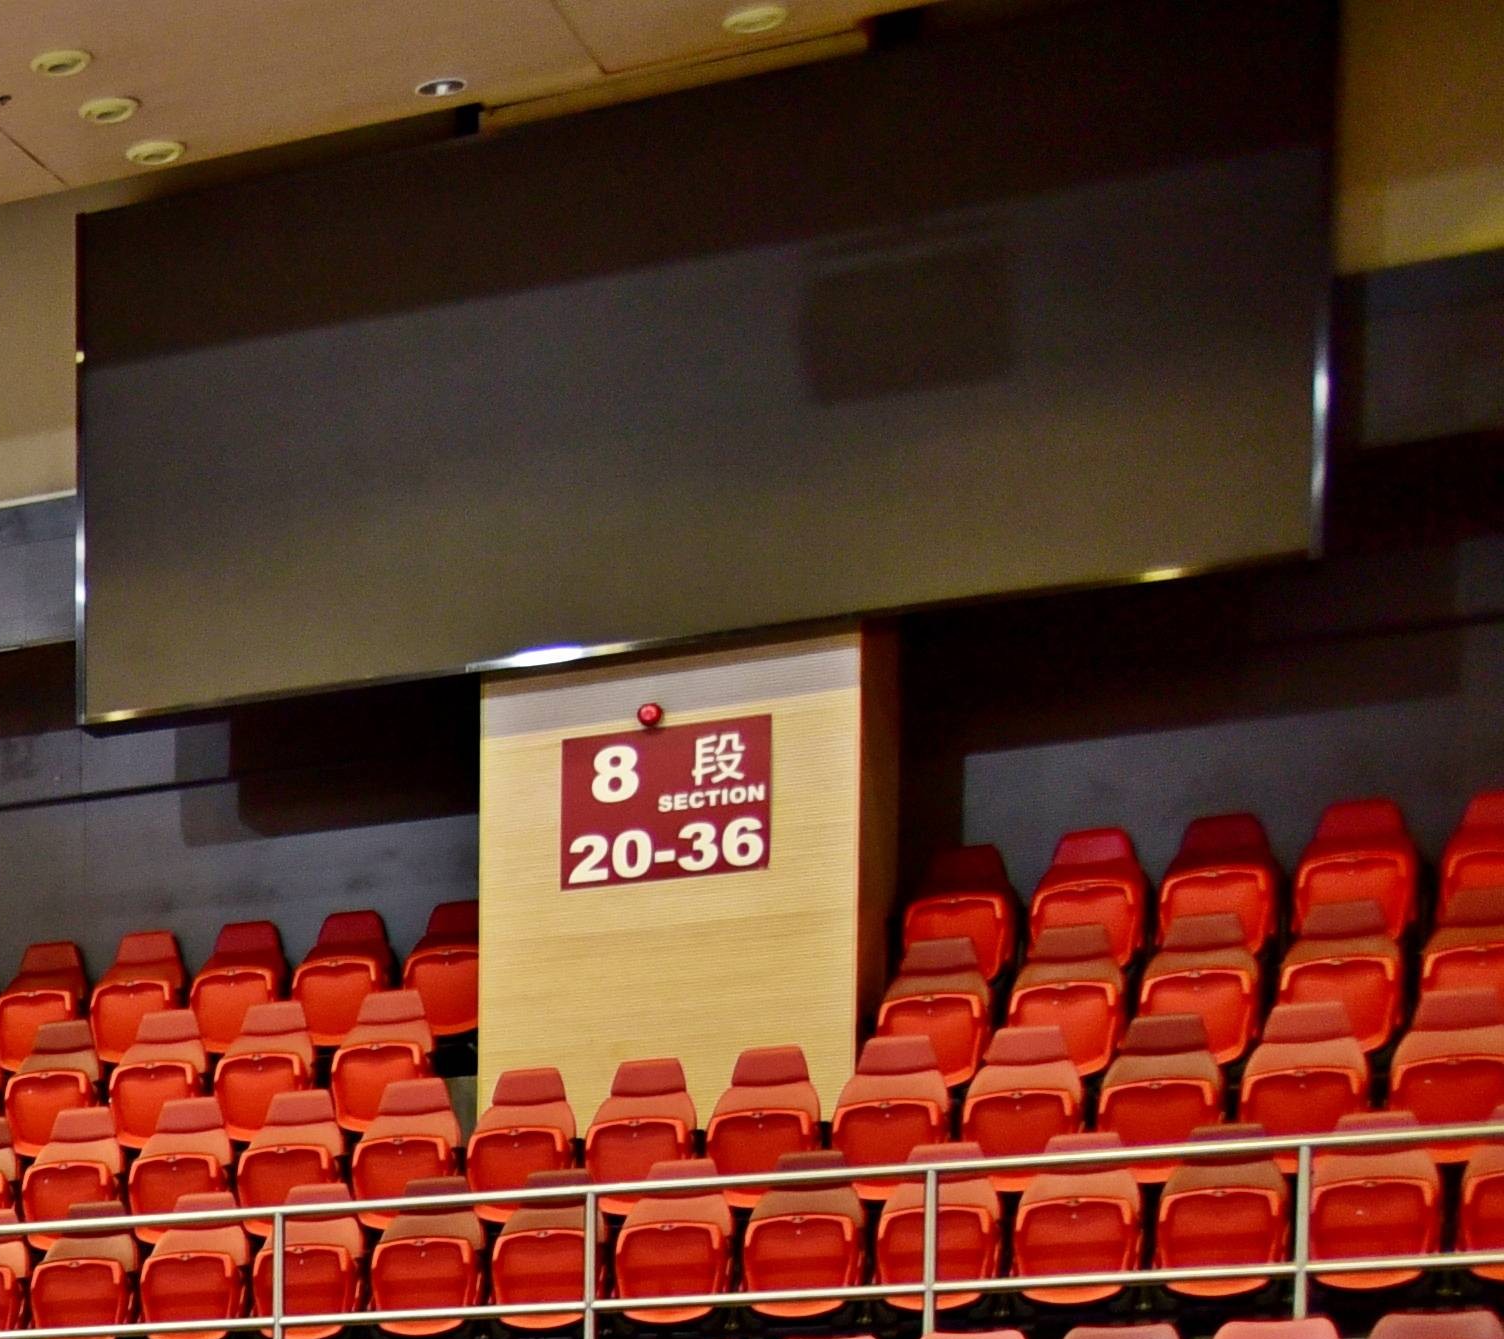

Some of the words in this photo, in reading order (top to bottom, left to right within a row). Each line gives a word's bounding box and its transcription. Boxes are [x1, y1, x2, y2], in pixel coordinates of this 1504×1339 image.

[591, 745, 640, 803] 8
[691, 732, 746, 786] 段
[657, 784, 766, 813] SECTION
[568, 817, 765, 885] 20-36
